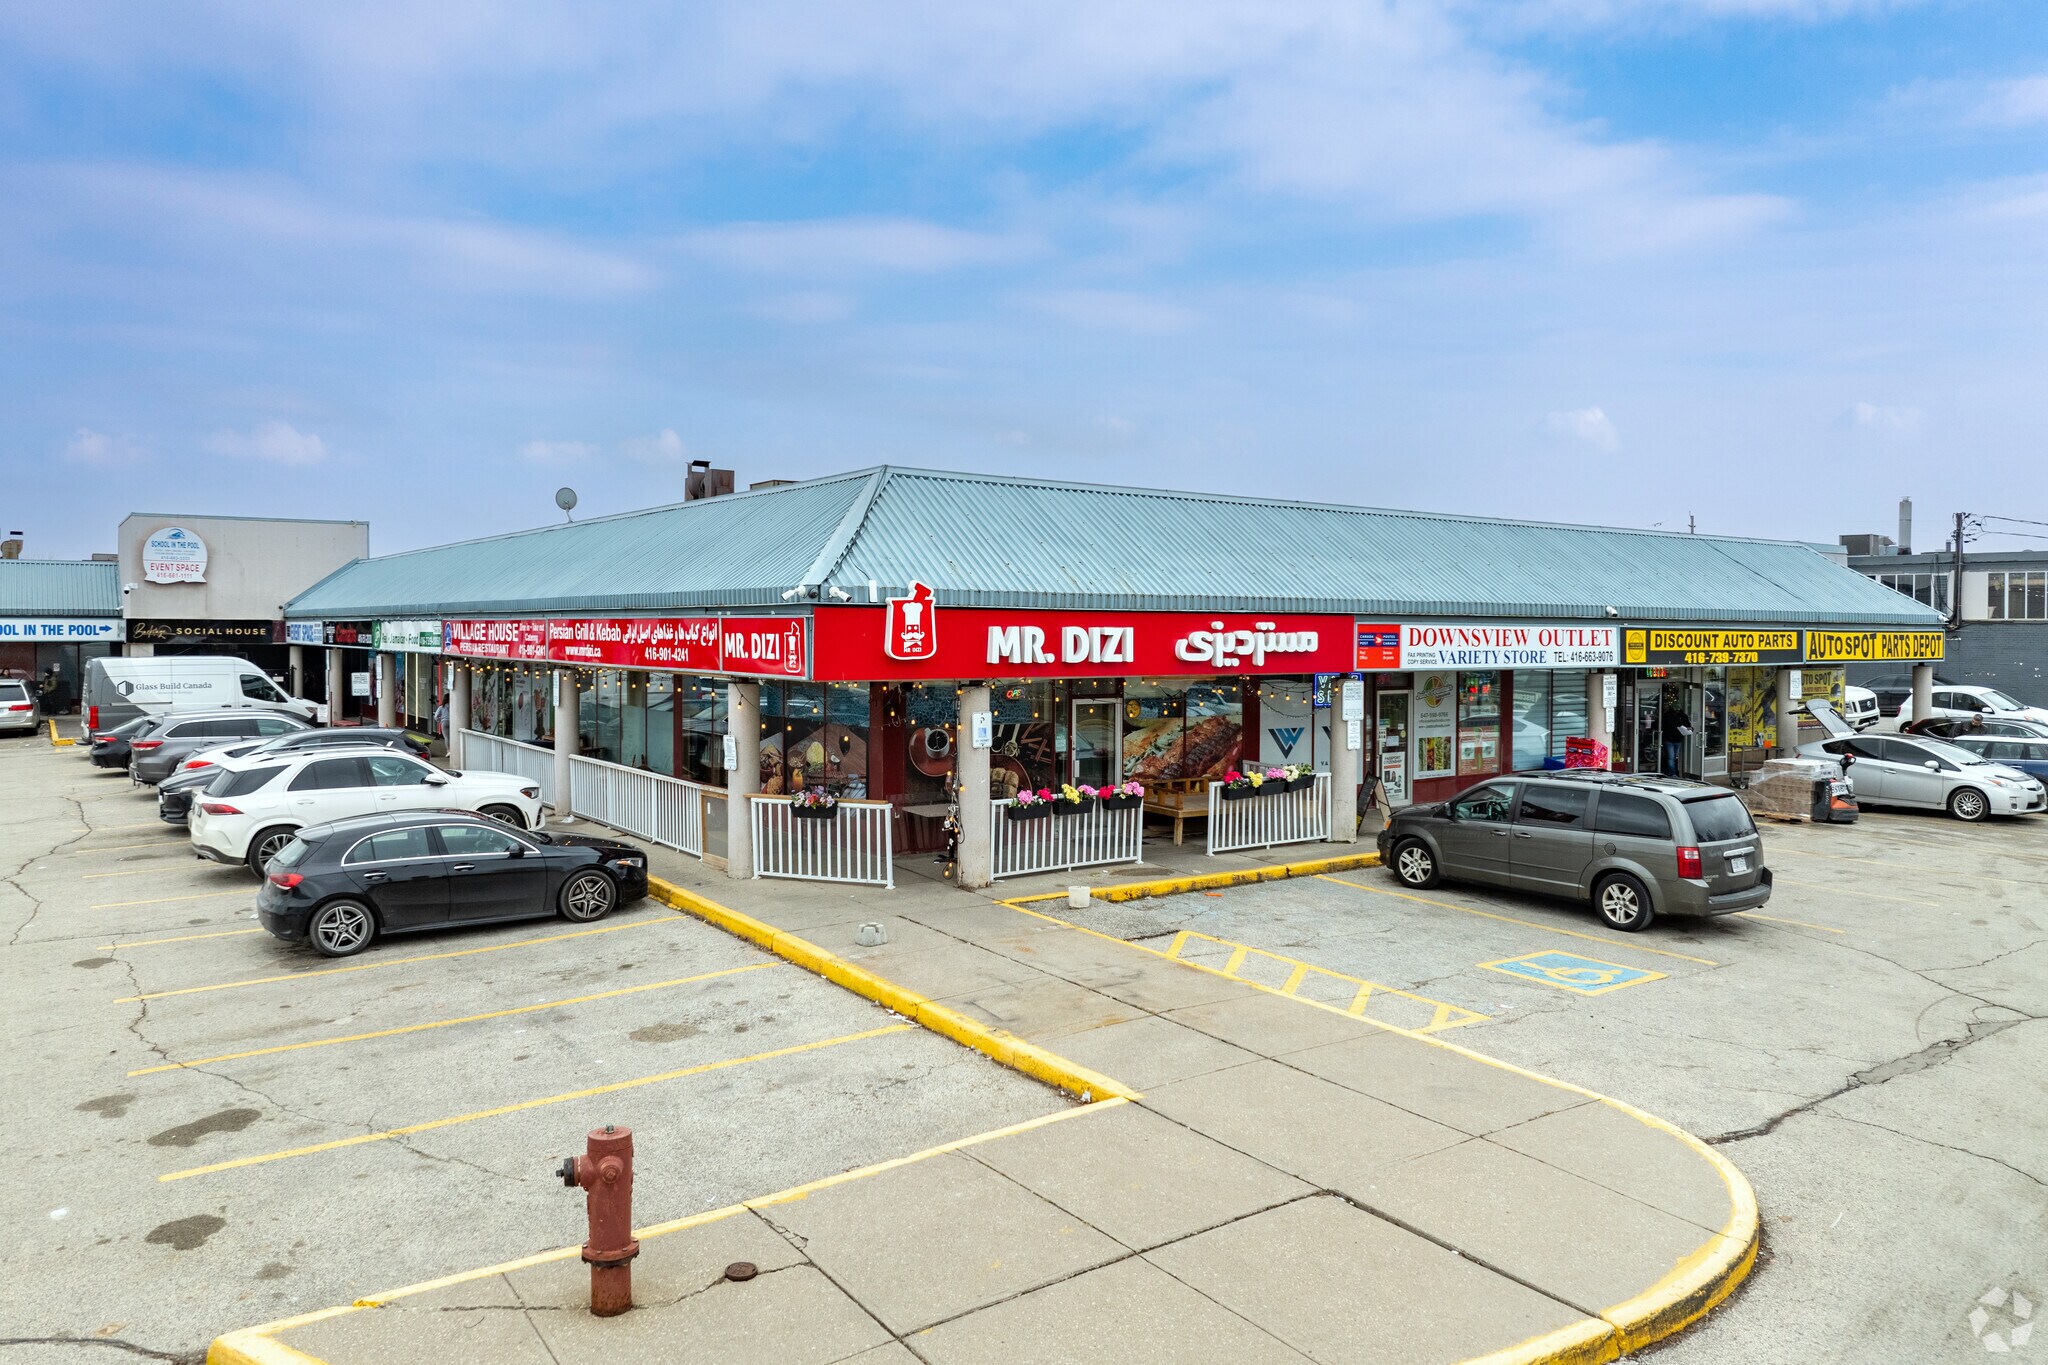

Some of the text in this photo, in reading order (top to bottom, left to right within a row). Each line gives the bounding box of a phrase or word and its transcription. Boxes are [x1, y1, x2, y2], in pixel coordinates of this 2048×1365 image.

[150, 562, 200, 572] EVENT SPACE
[23, 624, 36, 635] IN
[41, 624, 65, 636] THE
[68, 624, 100, 636] POOL
[176, 627, 222, 635] SOCIAL
[453, 623, 486, 640] VILLAGE
[488, 624, 518, 642] HOUSE
[549, 623, 621, 642] Persian Grill & Kebab
[1408, 627, 1613, 648] DOWNSVIEW OUTLET
[724, 632, 780, 660] MR. DIZI
[986, 625, 1134, 664] MR. DIZI
[1654, 633, 1793, 648] DISCOUNT AUTO PARTS
[1881, 634, 1911, 658] PARTS
[1913, 634, 1942, 657] DEPOT
[644, 646, 689, 662] 416-901-4241
[1438, 649, 1547, 665] VARIETY STORE
[1553, 651, 1614, 663] TEL: 416-663-9076
[1684, 651, 1759, 664] 416-739-7370
[135, 681, 213, 691] Glass Build Canada
[1814, 671, 1832, 687] SPOT
